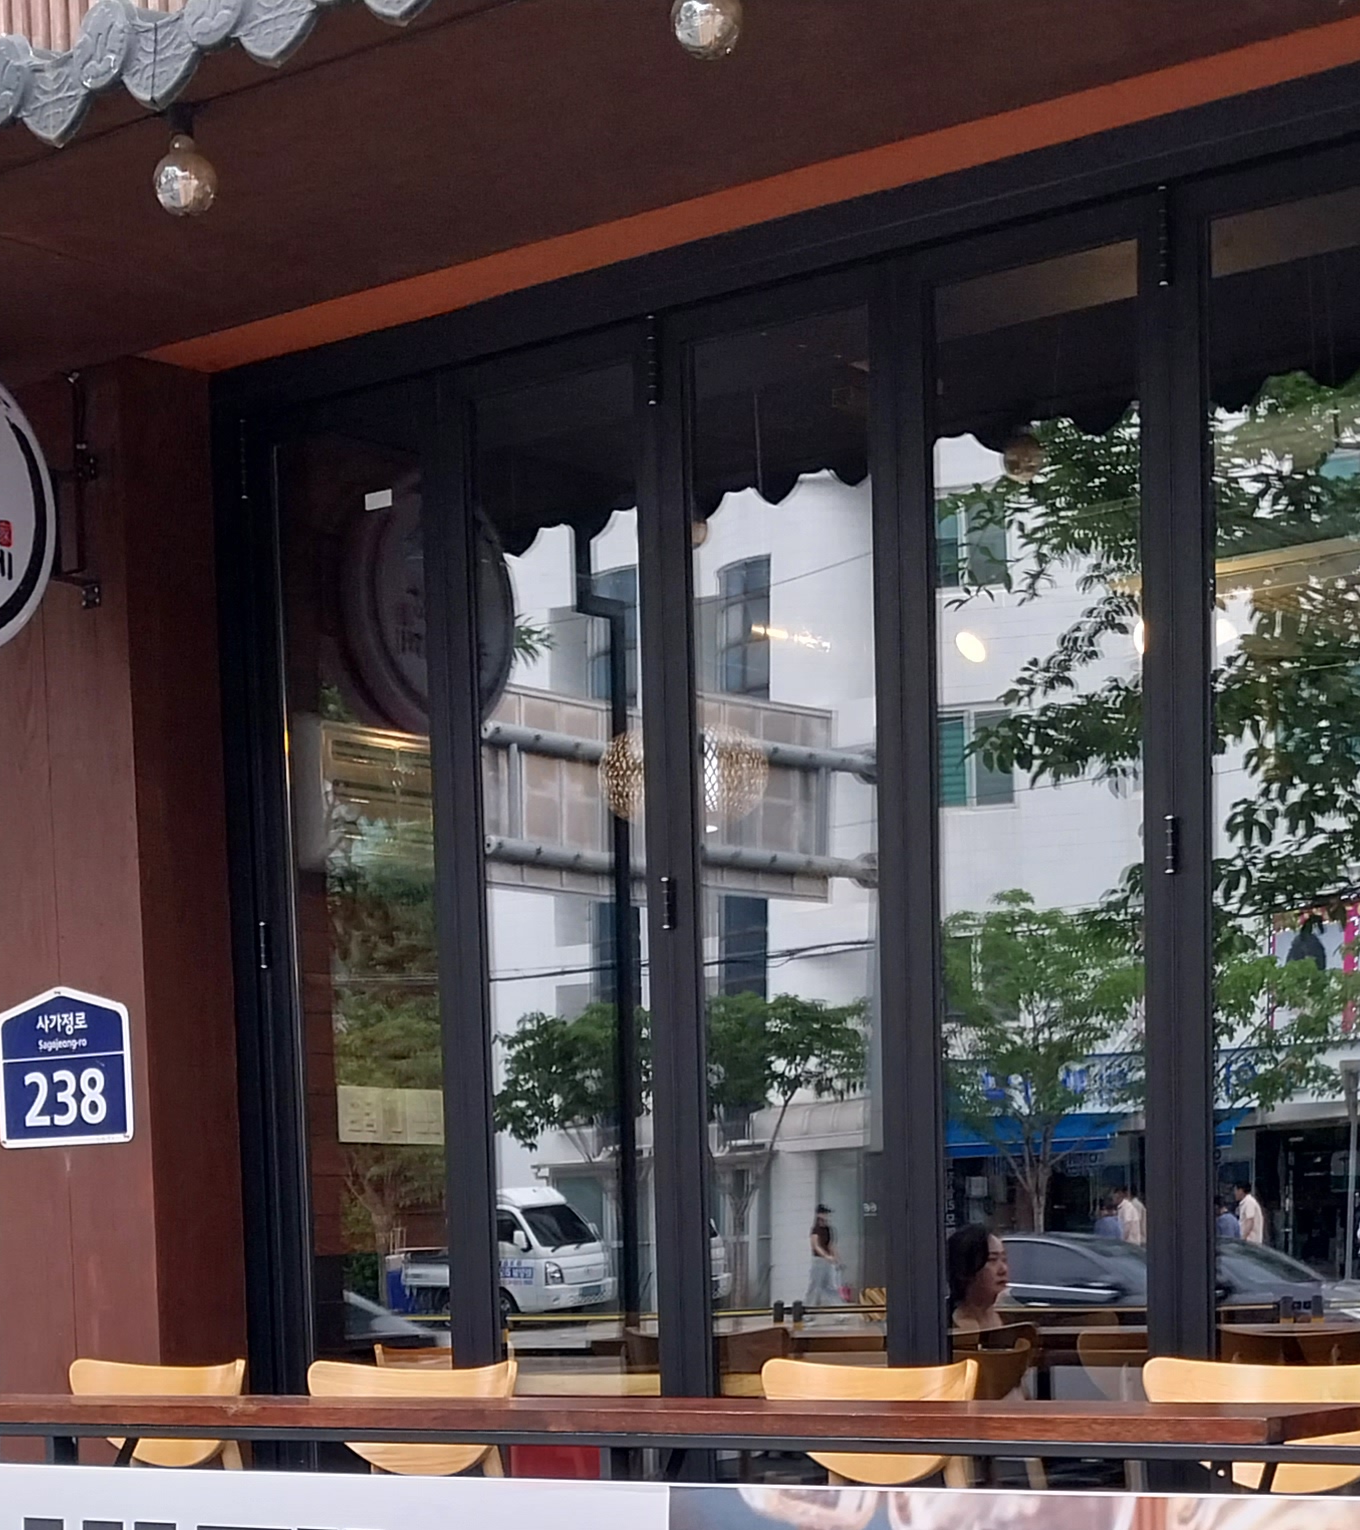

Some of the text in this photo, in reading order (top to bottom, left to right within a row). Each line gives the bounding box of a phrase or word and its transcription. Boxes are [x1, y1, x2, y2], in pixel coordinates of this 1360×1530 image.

[35, 1011, 88, 1035] 사가정로
[38, 1036, 88, 1052] Sagajeong-ro
[24, 1067, 107, 1128] 238
